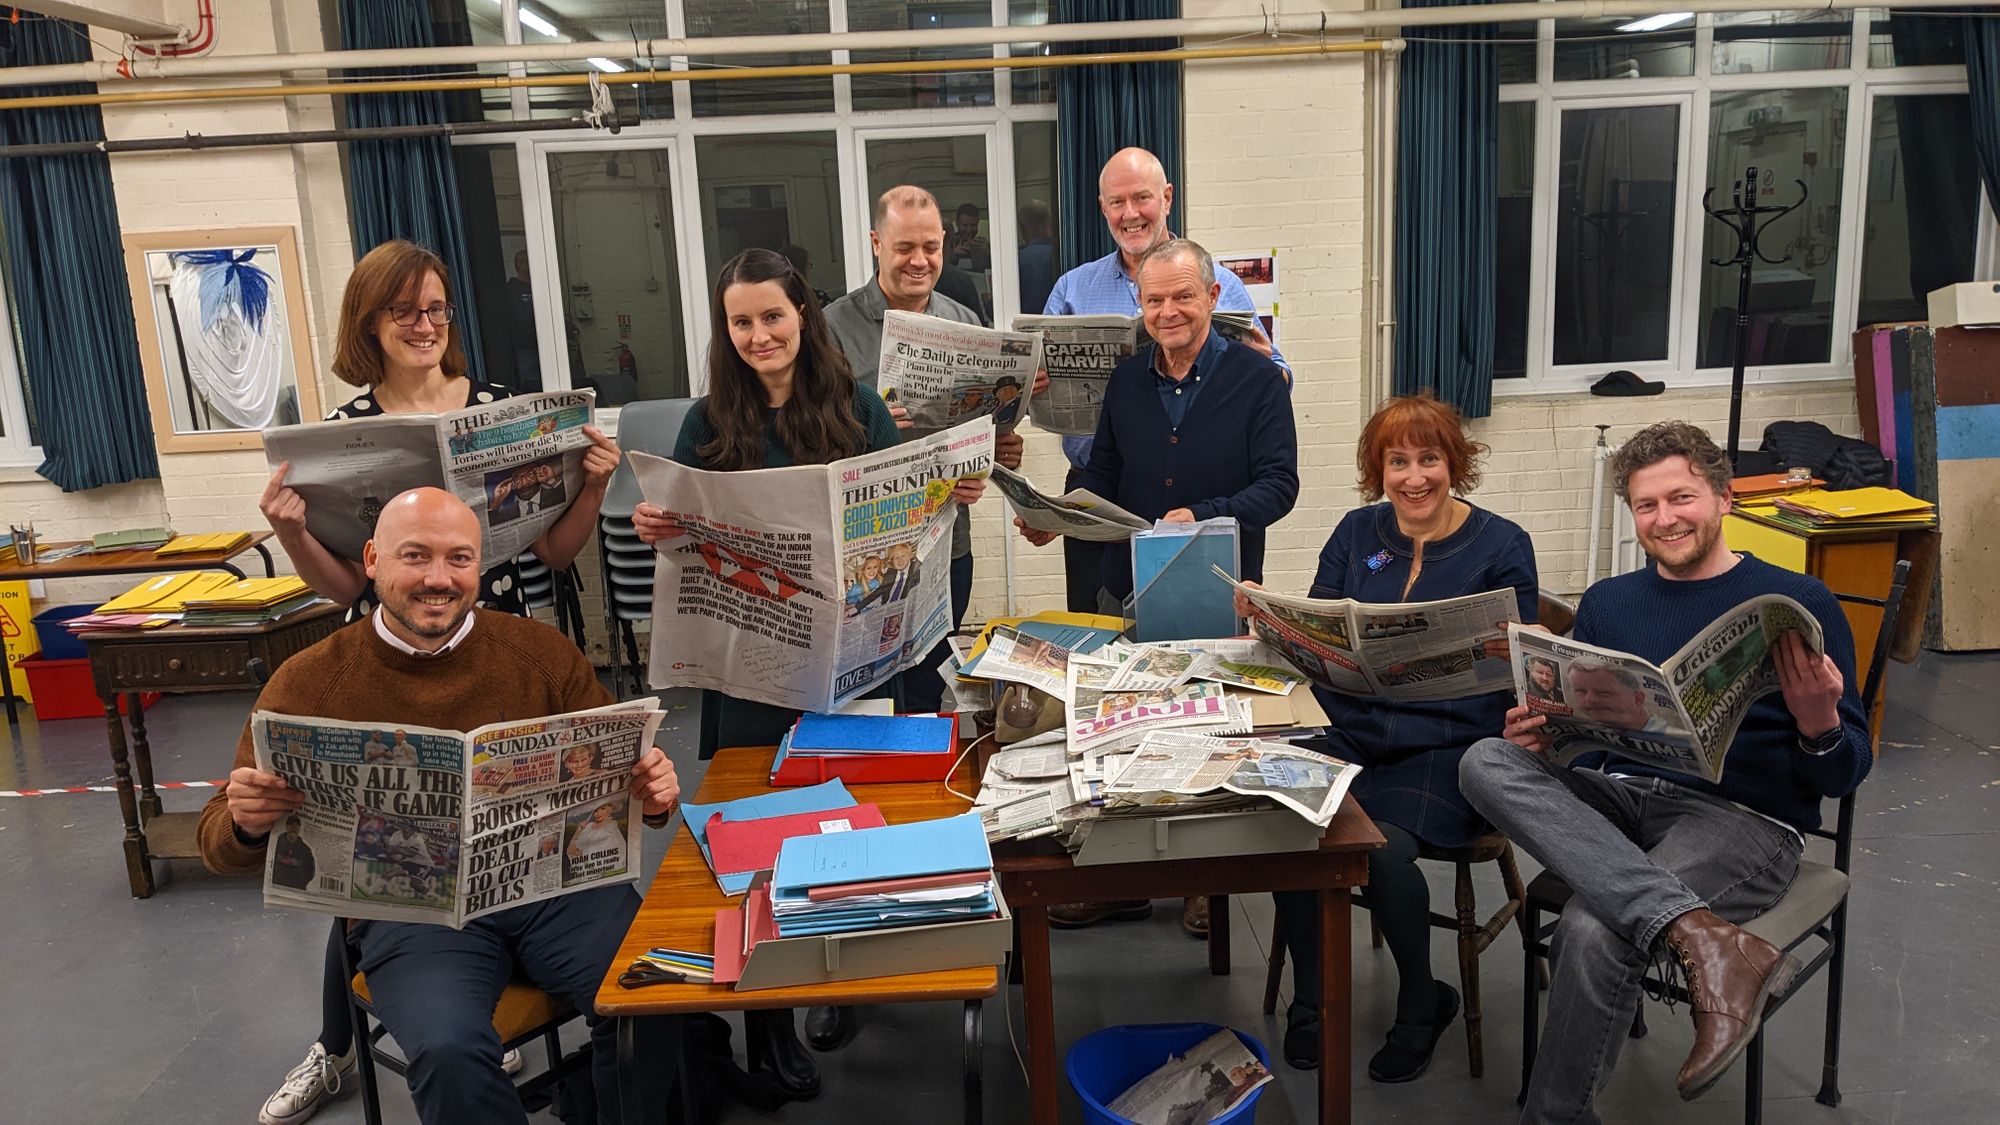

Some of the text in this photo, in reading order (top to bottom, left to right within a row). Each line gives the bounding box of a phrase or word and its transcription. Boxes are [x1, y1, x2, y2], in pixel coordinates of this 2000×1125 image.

[896, 342, 1018, 369] The Daily Telegraph
[1044, 343, 1121, 356] CAPTAIN
[905, 360, 925, 372] Plan
[925, 364, 933, 373] B
[933, 366, 944, 375] to
[944, 366, 954, 376] be
[1046, 356, 1118, 369] MARVEL
[903, 381, 950, 394] as PM plots
[904, 372, 943, 385] scrapped
[903, 389, 942, 401] fightback
[450, 393, 588, 431] THE TIMES
[477, 418, 539, 440] The healthiest
[452, 452, 485, 466] Tories
[485, 447, 506, 459] will
[506, 443, 525, 454] live
[524, 441, 536, 450] or
[537, 435, 552, 446] die
[552, 432, 564, 445] by
[477, 436, 503, 448] habits
[503, 434, 512, 442] to
[453, 444, 558, 475] economy, warns Patel
[842, 461, 885, 484] SALE BRITAIN'S
[842, 483, 880, 506] THE
[949, 452, 991, 479] TIMES
[843, 503, 875, 525] GOOD
[875, 490, 926, 517] UNIVERSI
[708, 519, 729, 531] THINK
[730, 525, 743, 534] WE
[762, 532, 775, 541] WE
[777, 533, 796, 541] TALK
[797, 533, 812, 541] FOR
[843, 513, 876, 543] GUIDE
[878, 511, 908, 534] 2020
[907, 505, 923, 519] FREE
[755, 546, 814, 561] KENYAN COFFEE.
[767, 541, 812, 552] OF AN INDIAN
[781, 560, 812, 571] COURAGE
[680, 576, 813, 624] BUILT IN A DAY AS WE STRUGGLE WITH
[681, 565, 814, 615] WHERE WASN'T
[678, 596, 813, 642] PARDON OUR WE ARE NOT AN ISLAND.
[679, 586, 812, 633] SWEDISH FLATPACKS AND INEVITABLY HAVE TO
[676, 605, 813, 650] WE'RE PART OF SOMETHING FAR, FAR BIGGER.
[1702, 620, 1738, 650] Coventry
[1288, 629, 1310, 643] WALL
[1310, 641, 1358, 669] INSULATION
[1551, 642, 1581, 658] Telegraph
[1673, 613, 1760, 686] Telegraph
[836, 666, 864, 693] LOVE
[1540, 698, 1567, 708] ENGLAND
[269, 721, 313, 737] Express
[434, 736, 455, 744] future
[475, 725, 543, 745] FREE INSIDE
[487, 719, 647, 758] SUNDAY EXPRESS
[324, 749, 362, 760] Manchester
[338, 743, 359, 751] attack
[435, 744, 462, 754] cricket's
[451, 753, 460, 761] air
[1628, 737, 1693, 760] TIME
[441, 759, 458, 768] again
[512, 752, 556, 766] FREE LUXURY
[513, 759, 556, 773] SKIN HAIR
[271, 751, 463, 797] GIVE US ALL THE
[510, 777, 538, 788] WORTH
[515, 770, 539, 780] TRAVEL
[363, 788, 387, 811] IF
[392, 792, 462, 819] GAME
[471, 772, 631, 837] BORIS: 'MIGHTY
[471, 819, 537, 855] TRADE
[468, 840, 525, 877] DEAL
[570, 847, 620, 865] JOAN COLLINS
[603, 856, 620, 866] really
[467, 856, 534, 895] TO CUT
[586, 864, 615, 876] important
[464, 879, 525, 916] BILLS
